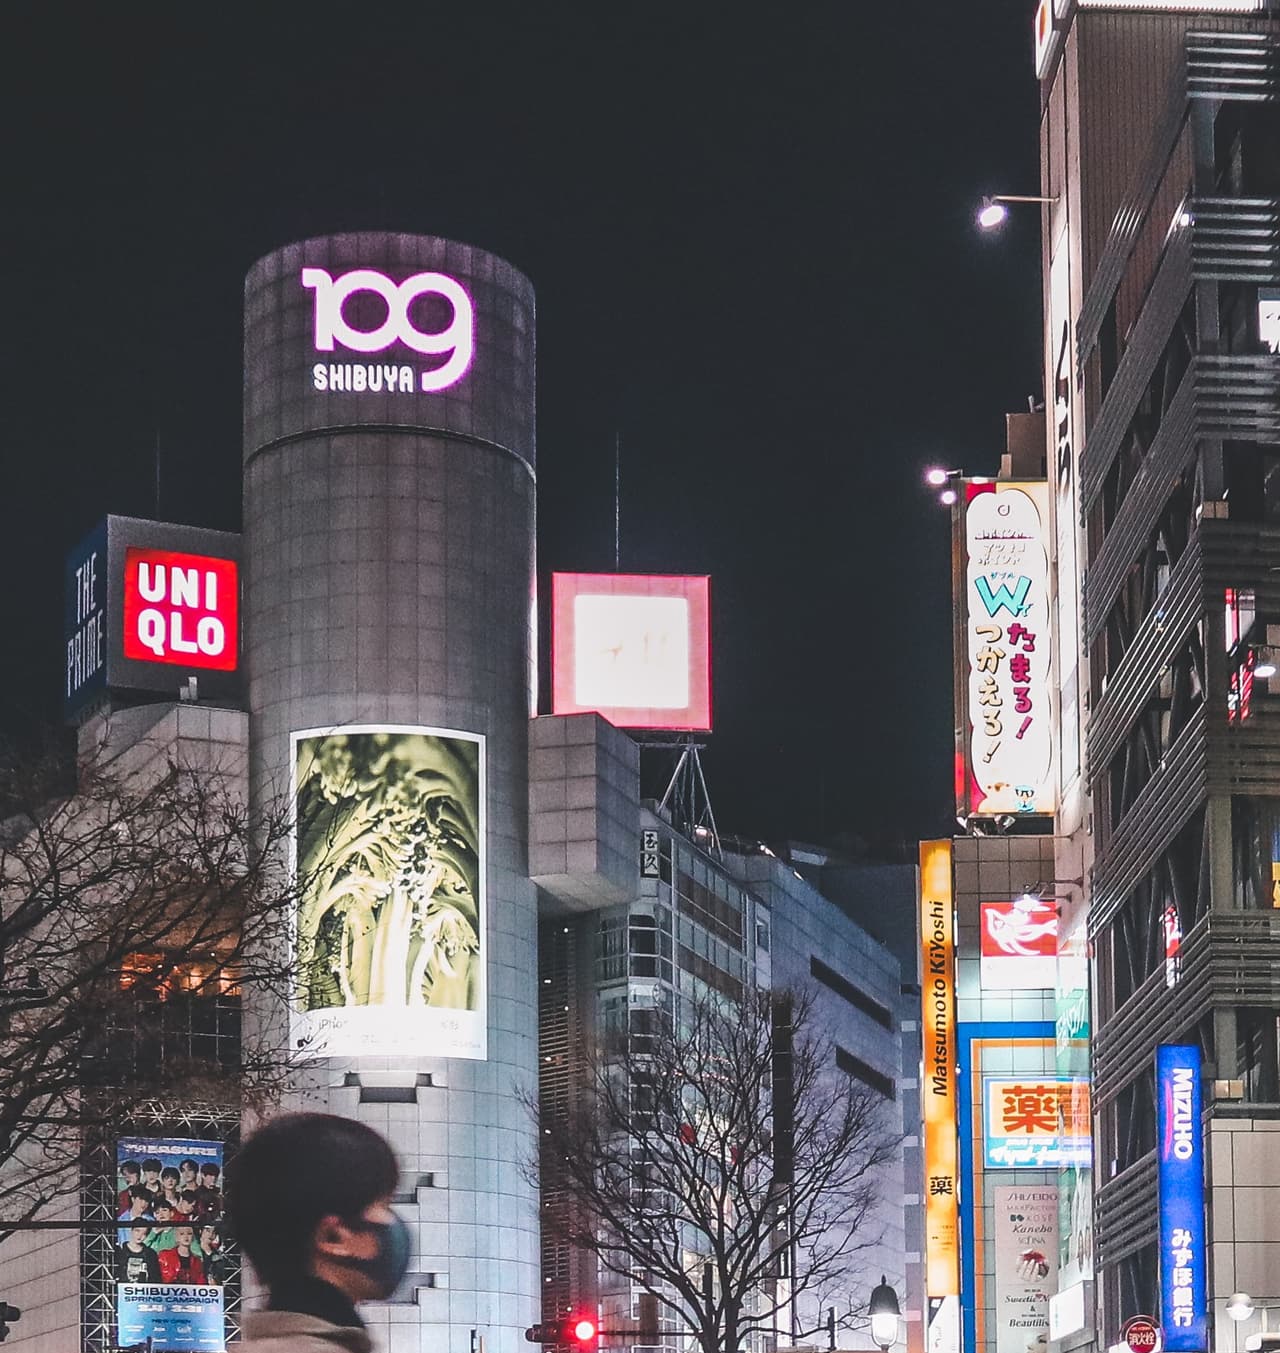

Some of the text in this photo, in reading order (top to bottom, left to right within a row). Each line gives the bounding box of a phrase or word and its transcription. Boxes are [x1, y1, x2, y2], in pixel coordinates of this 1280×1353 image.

[302, 267, 476, 392] 109
[313, 363, 414, 393] SHIBUYA
[76, 552, 97, 625] THE
[138, 562, 218, 611] UNI
[67, 608, 103, 697] PRIME
[137, 608, 225, 656] QLO
[931, 977, 948, 1097] Matsumoto
[1002, 1085, 1058, 1134] 薬
[1172, 1067, 1194, 1160] MIZUHO
[929, 1175, 953, 1196] 薬
[1007, 1192, 1058, 1201] SHISEIDO
[1012, 1223, 1054, 1234] Kanebo
[124, 1286, 219, 1298] SHIBUYA 109
[165, 1296, 219, 1304] CAMPAIGN
[1171, 1228, 1195, 1328] みずほ銀行
[1128, 1331, 1155, 1346] 消火栓
